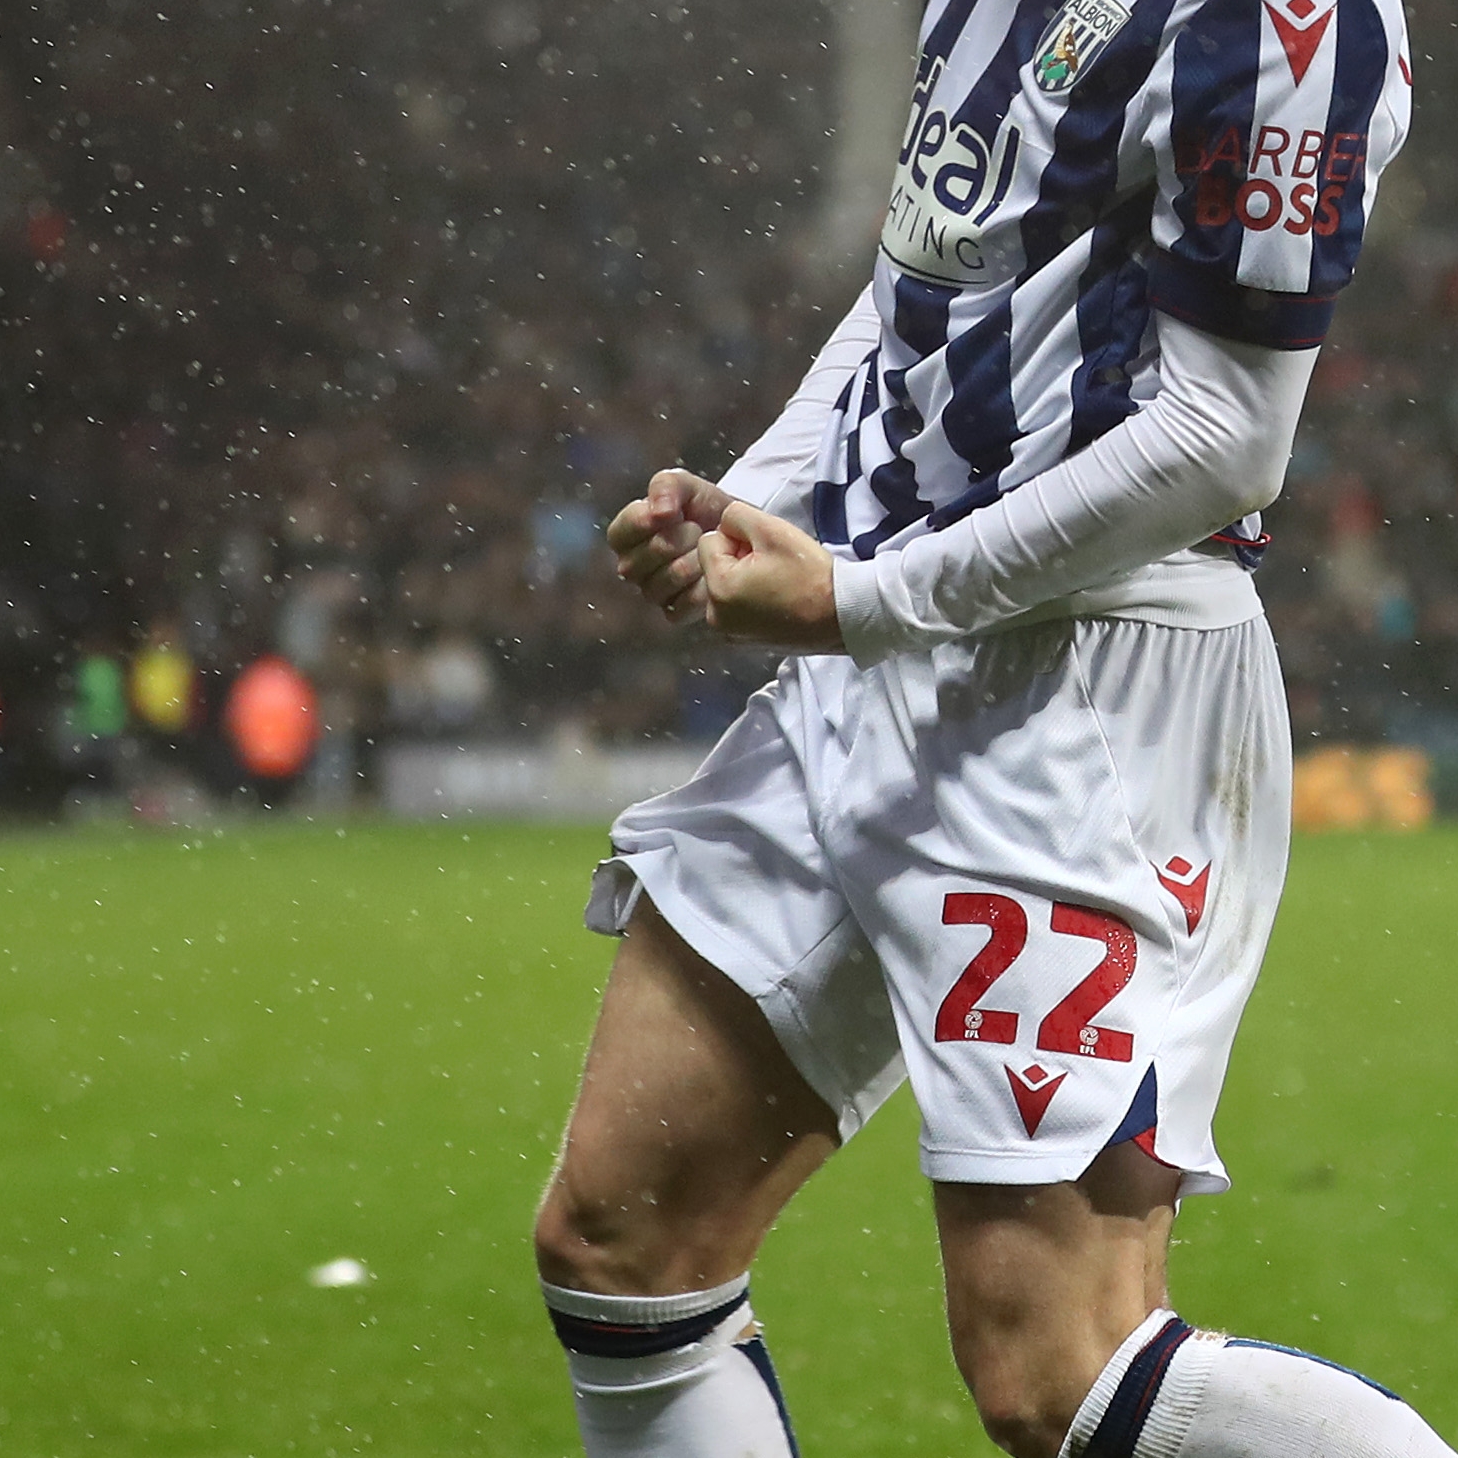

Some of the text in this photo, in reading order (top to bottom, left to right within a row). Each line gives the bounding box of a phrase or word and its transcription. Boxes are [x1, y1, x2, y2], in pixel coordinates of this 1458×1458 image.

[899, 57, 1020, 228] deal
[889, 186, 985, 270] ATING
[1195, 178, 1345, 236] BOSS
[935, 892, 1138, 1063] 22
